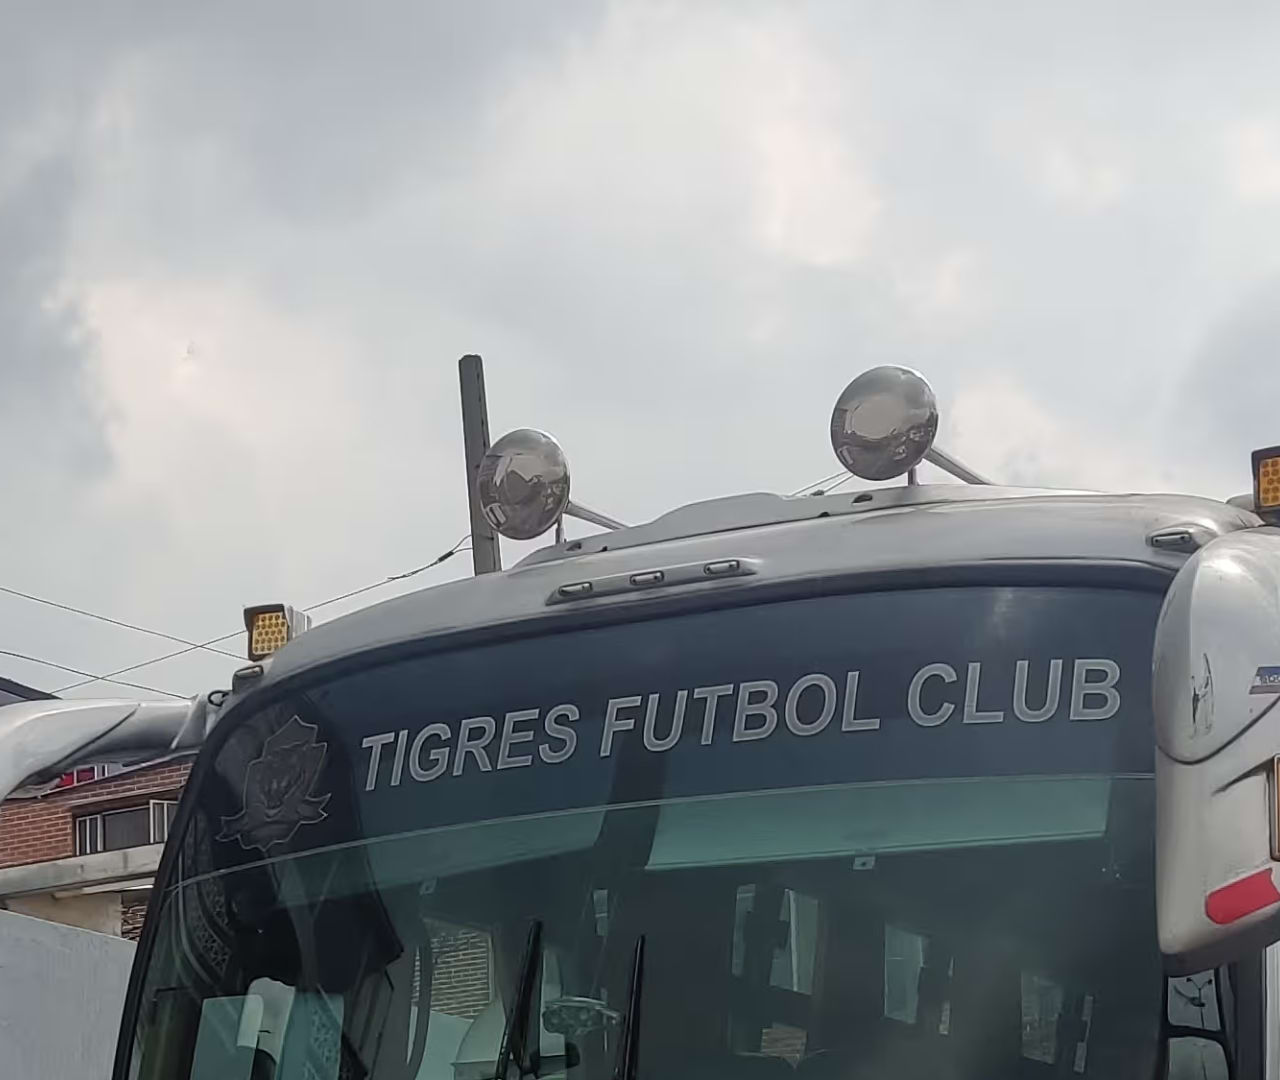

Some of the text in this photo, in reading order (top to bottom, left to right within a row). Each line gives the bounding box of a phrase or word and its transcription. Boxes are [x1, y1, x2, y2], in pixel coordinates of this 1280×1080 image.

[361, 658, 1122, 792] TIGRES FUTBOL CLUB
